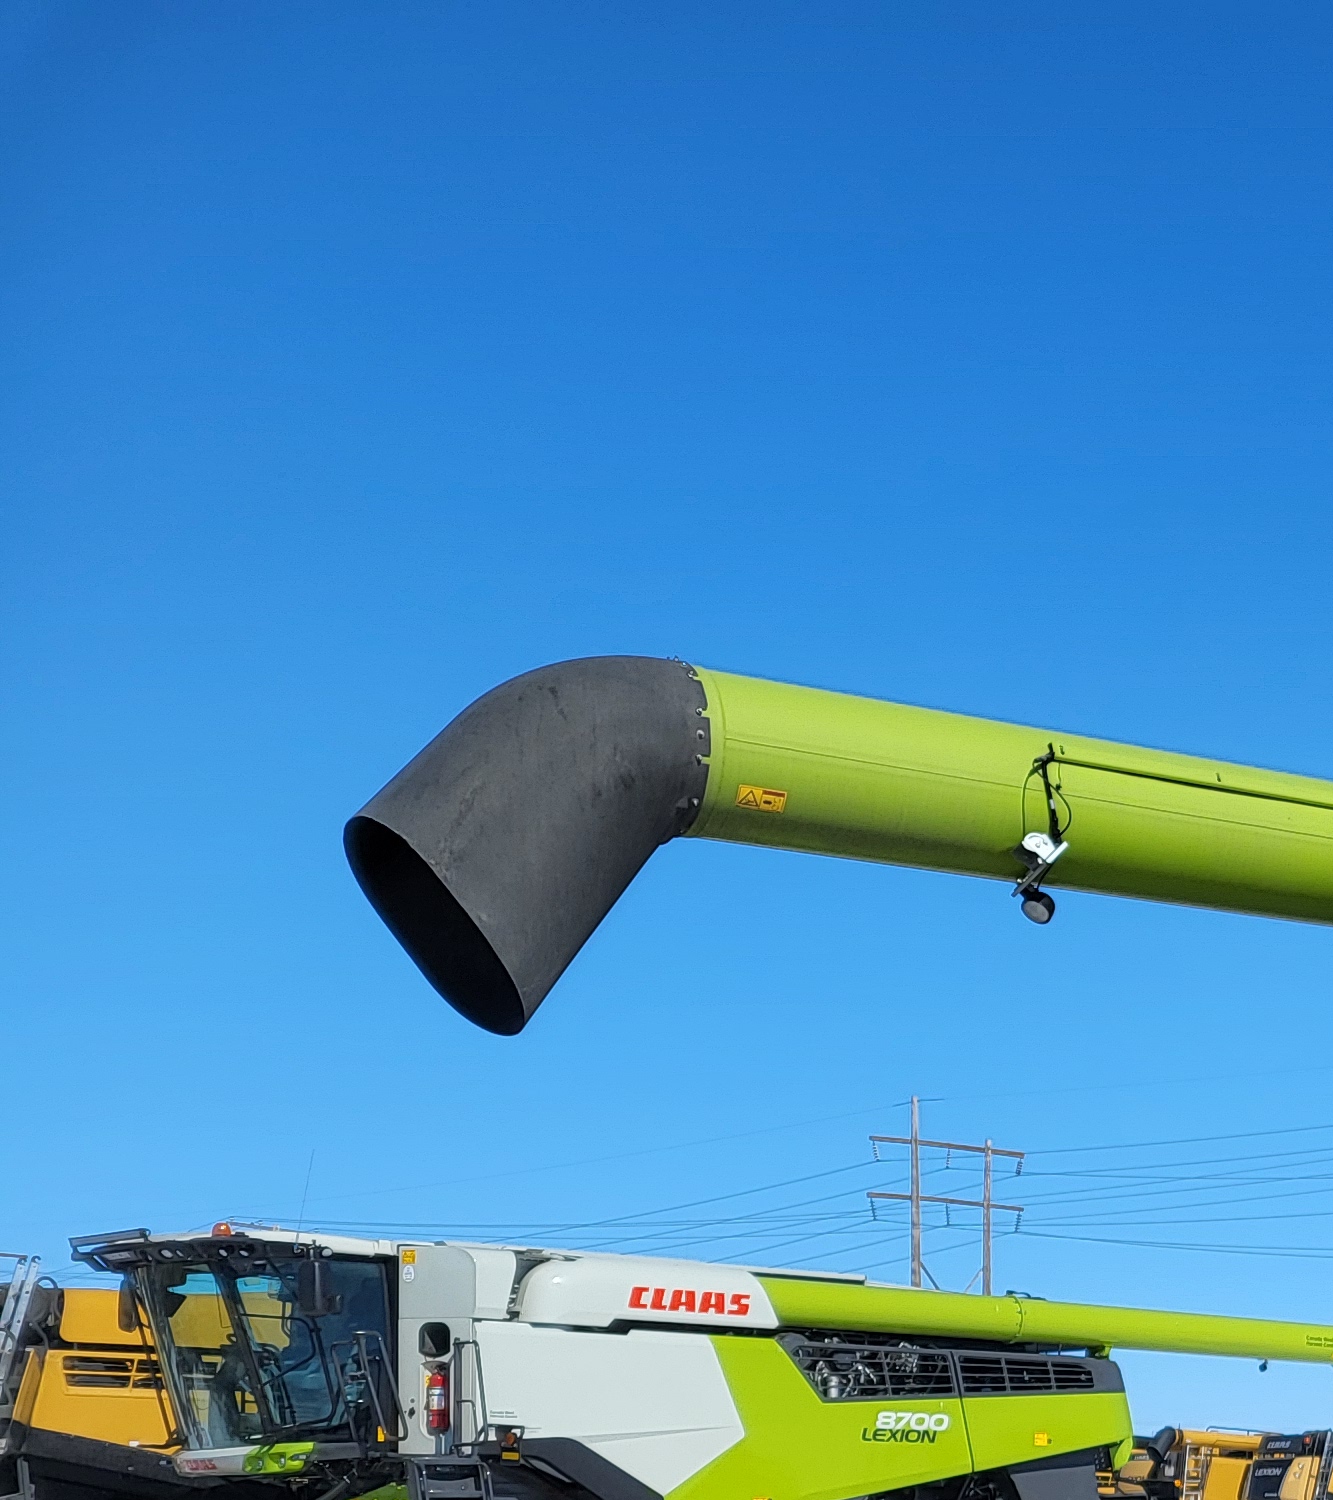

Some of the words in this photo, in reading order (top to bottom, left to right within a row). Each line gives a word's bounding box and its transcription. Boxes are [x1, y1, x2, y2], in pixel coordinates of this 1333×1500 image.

[628, 1286, 751, 1316] CLAAS
[876, 1411, 949, 1431] 8700
[861, 1428, 937, 1443] LEXION
[1255, 1467, 1282, 1477] LEXION
